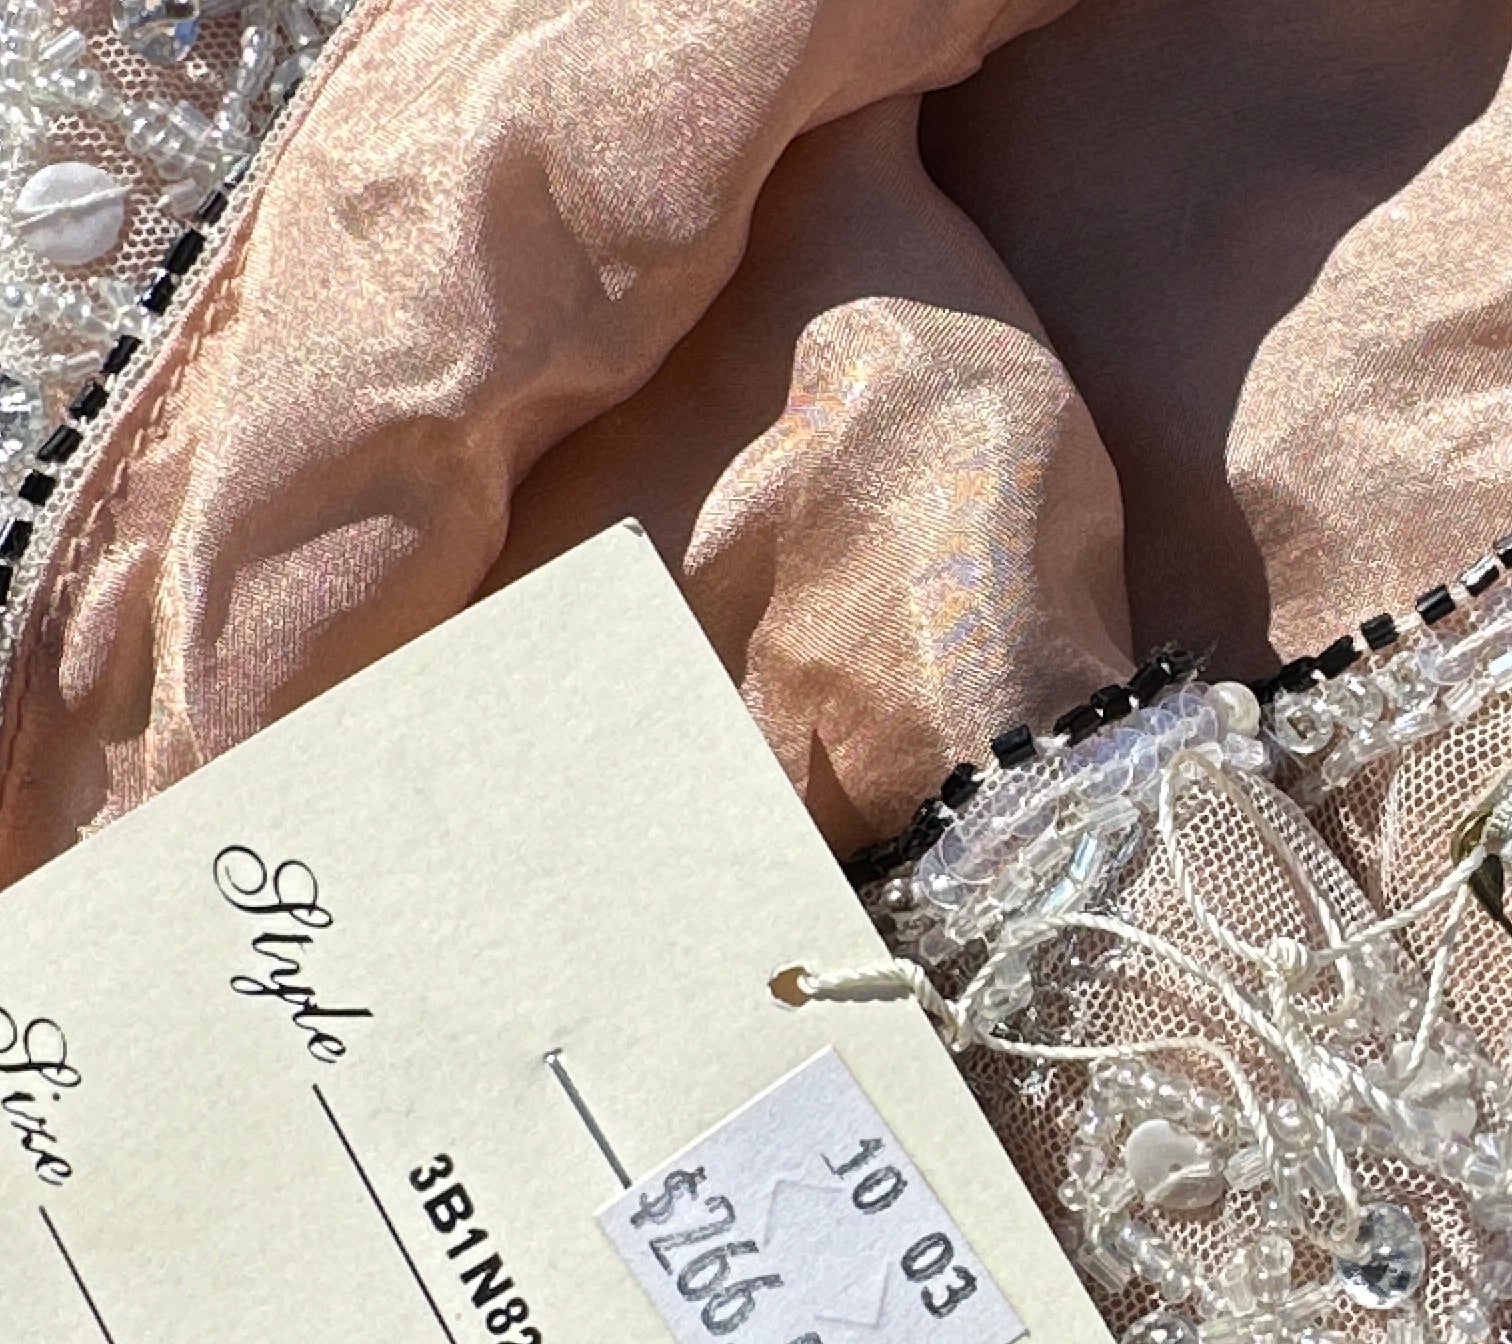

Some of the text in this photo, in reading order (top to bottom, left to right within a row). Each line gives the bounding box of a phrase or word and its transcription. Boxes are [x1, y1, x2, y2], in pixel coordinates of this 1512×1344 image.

[213, 845, 374, 1063] Style
[0, 1007, 82, 1186] Size
[821, 1138, 978, 1319] 10 03
